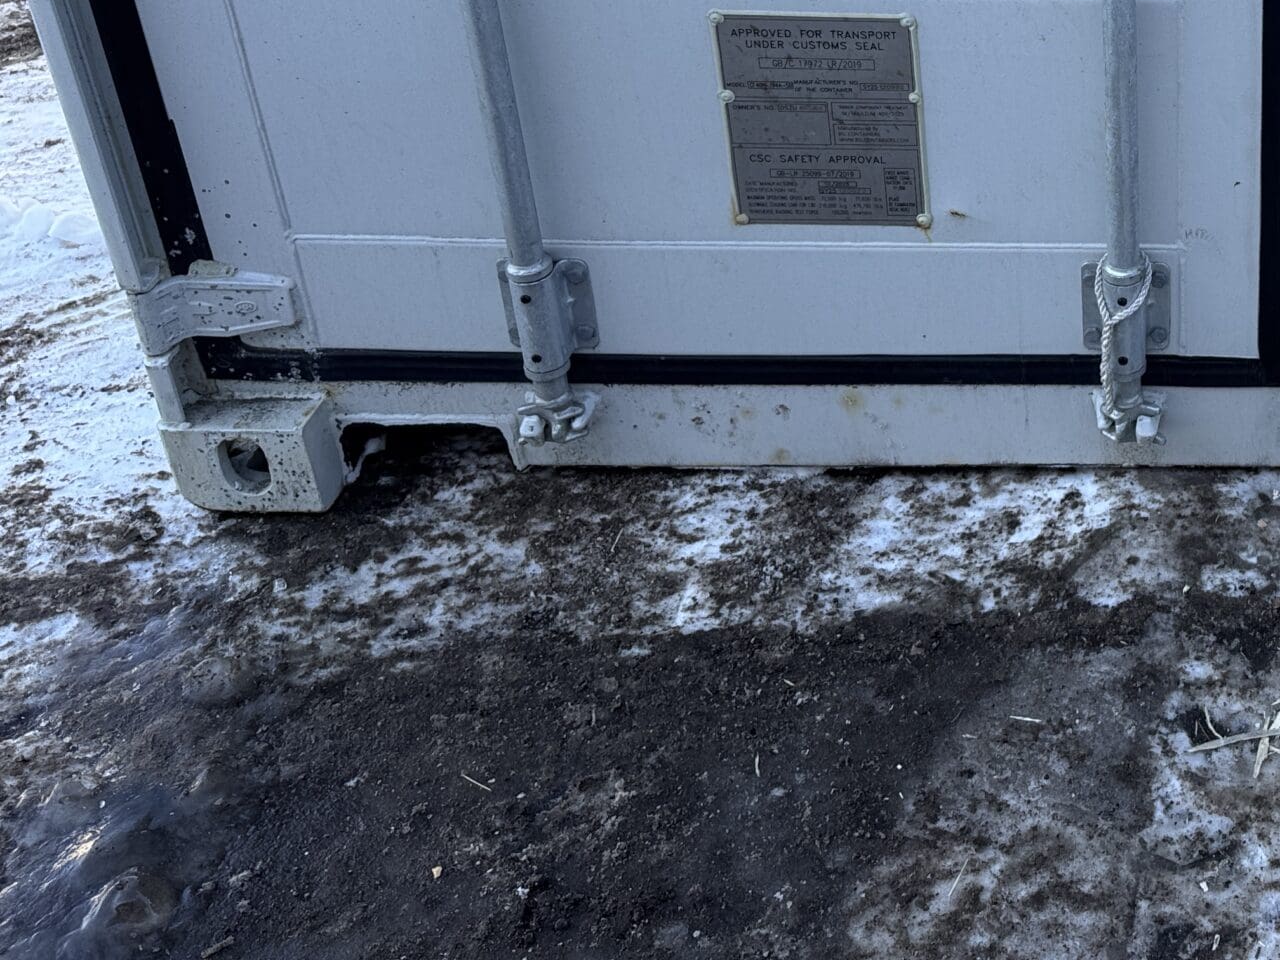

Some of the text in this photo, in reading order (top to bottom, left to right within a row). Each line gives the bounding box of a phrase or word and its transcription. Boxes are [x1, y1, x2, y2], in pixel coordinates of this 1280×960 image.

[731, 28, 897, 40] APPROVED FOR TRANSPORT
[745, 40, 885, 51] UNDER CUSTOMS SEAL
[749, 154, 887, 165] CSC SAFETY APPROVAL
